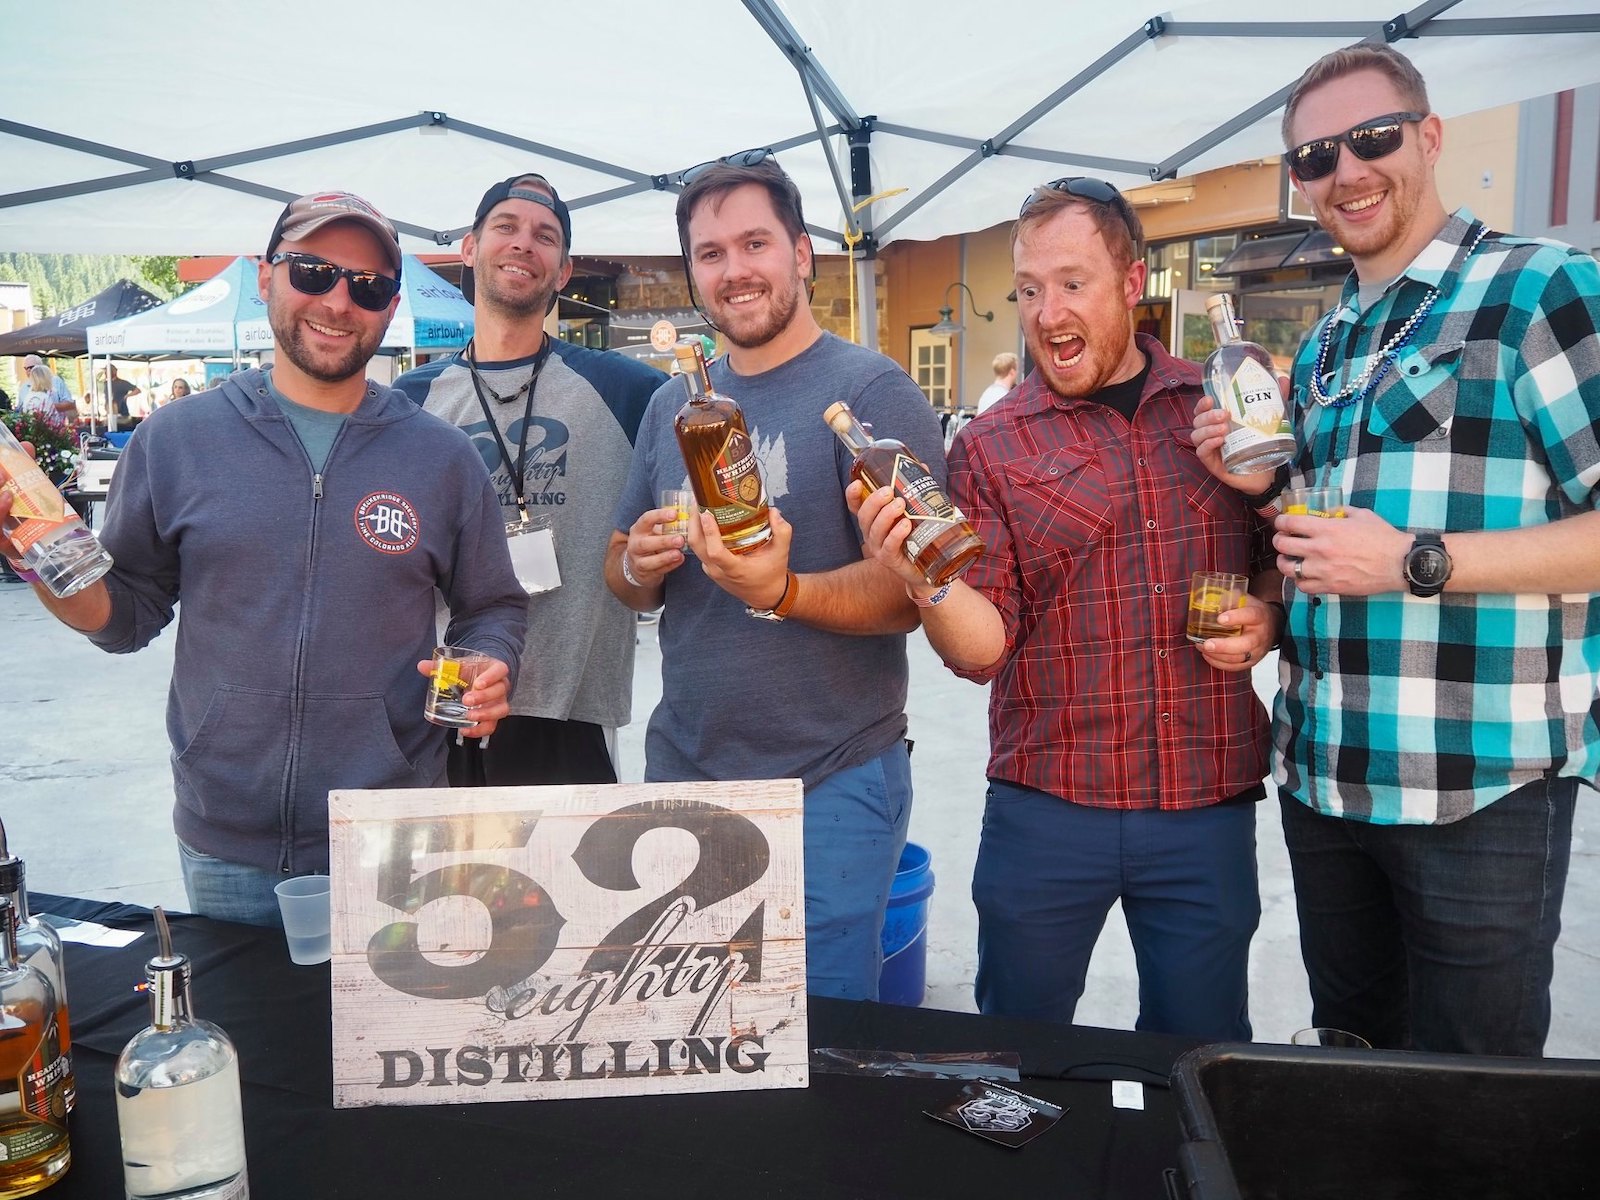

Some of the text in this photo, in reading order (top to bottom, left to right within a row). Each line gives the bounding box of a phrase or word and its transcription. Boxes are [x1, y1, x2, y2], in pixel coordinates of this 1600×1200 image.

[245, 326, 272, 341] airlou
[1244, 391, 1272, 404] GIN
[366, 799, 771, 1001] 52
[485, 895, 751, 1044] eighty
[376, 1035, 772, 1089] DISTILLING
[984, 1090, 1039, 1115] DISTILLING
